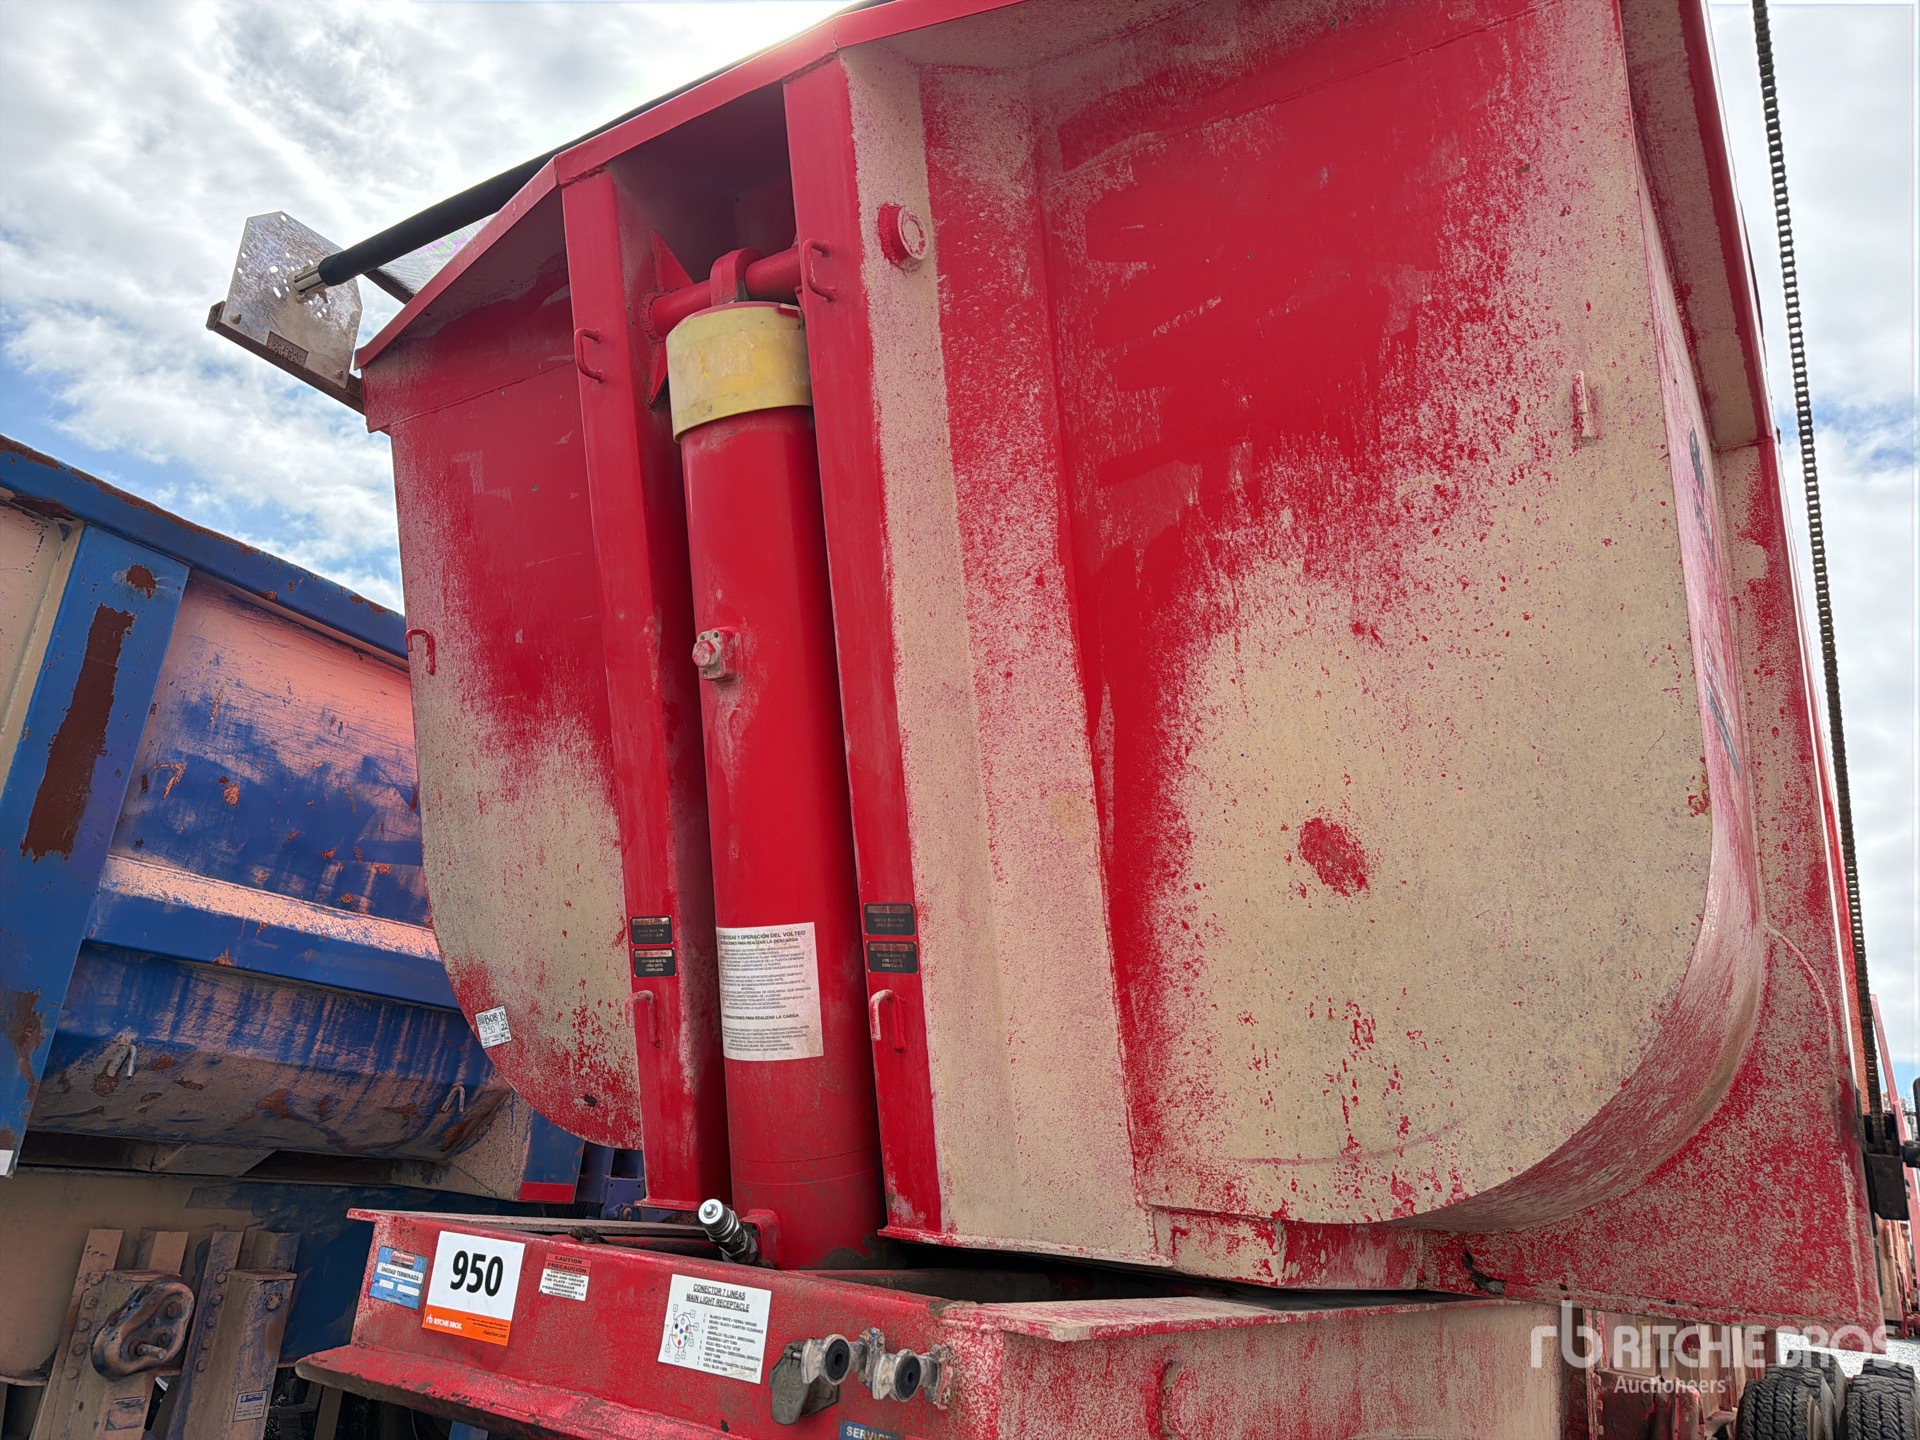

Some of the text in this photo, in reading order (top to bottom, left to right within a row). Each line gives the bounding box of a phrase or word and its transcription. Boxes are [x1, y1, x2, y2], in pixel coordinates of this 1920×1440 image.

[555, 1256, 582, 1264] CAUTION
[381, 1266, 396, 1275] UNIDAD
[397, 1270, 420, 1281] TERMINADA
[450, 1250, 504, 1297] 950
[693, 1284, 722, 1297] CONECTOR
[727, 1290, 746, 1300] LINEAS
[686, 1293, 750, 1312] MAIN LIGHT RECEPTACLE
